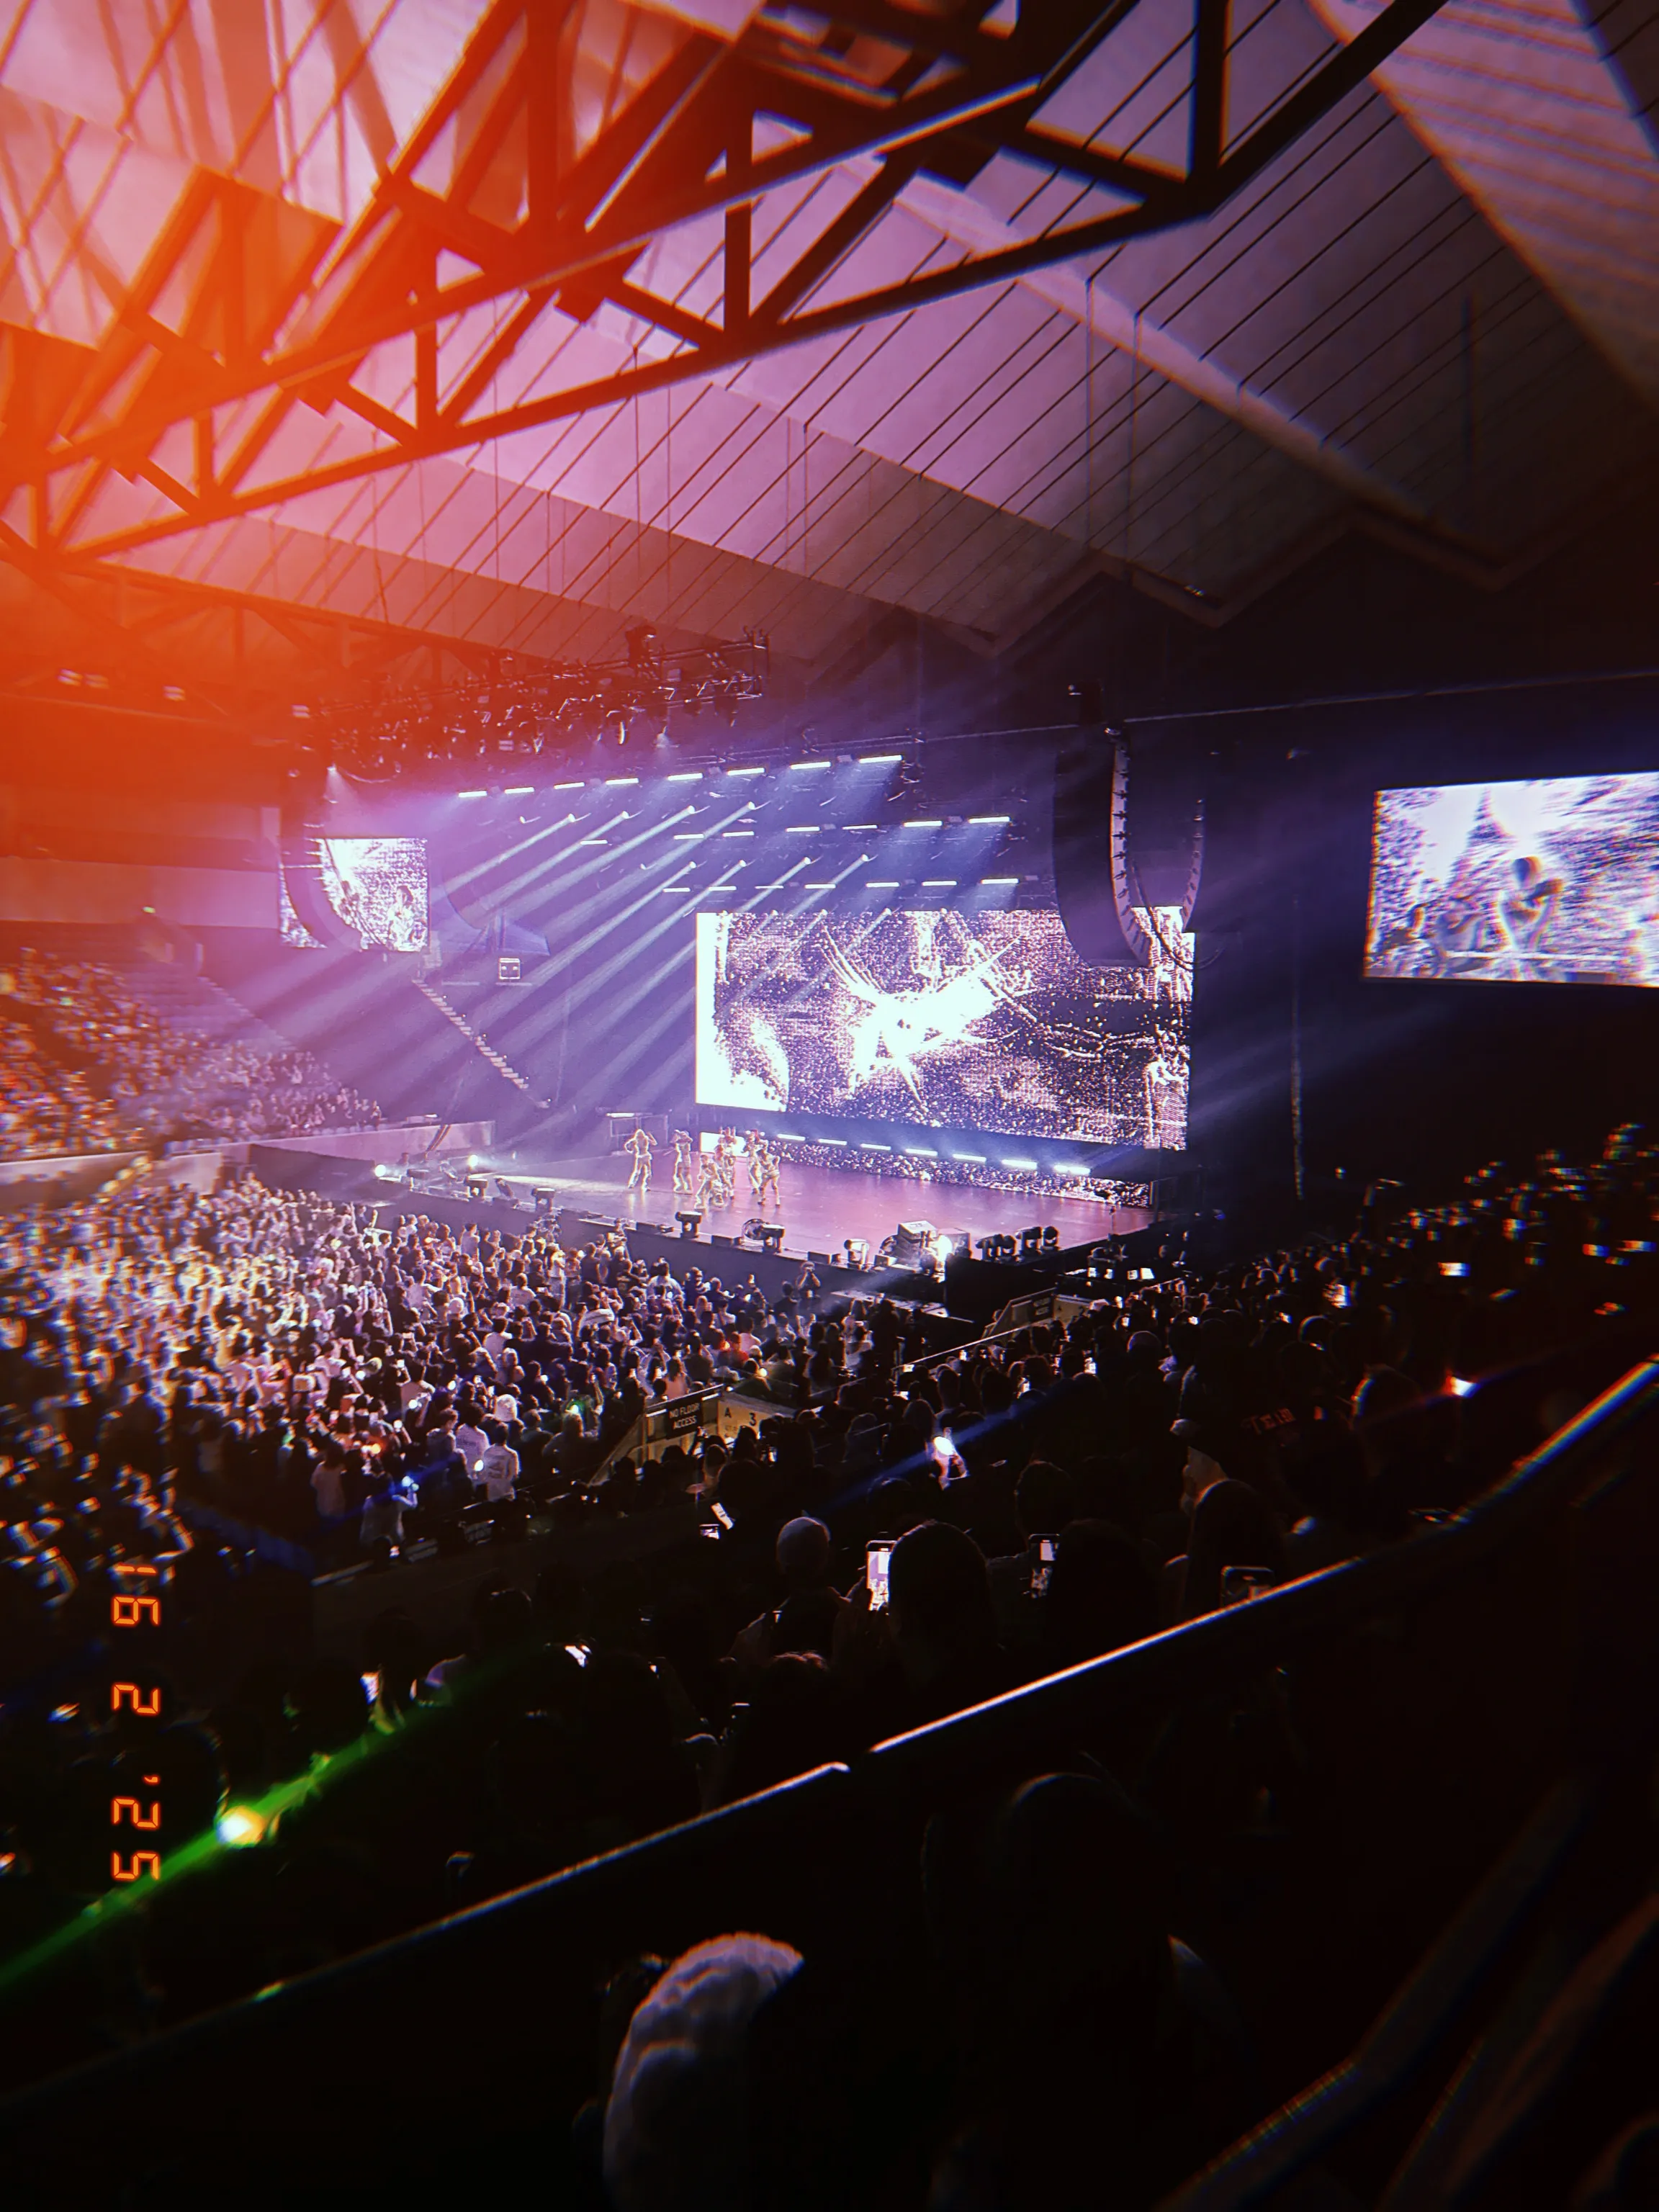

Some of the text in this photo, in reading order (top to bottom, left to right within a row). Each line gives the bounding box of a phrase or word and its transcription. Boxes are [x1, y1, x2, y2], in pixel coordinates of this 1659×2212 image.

[669, 1402, 701, 1419] NO FLOOR
[724, 1407, 732, 1418] A
[673, 1415, 697, 1429] ACCESS
[749, 1412, 757, 1426] 3
